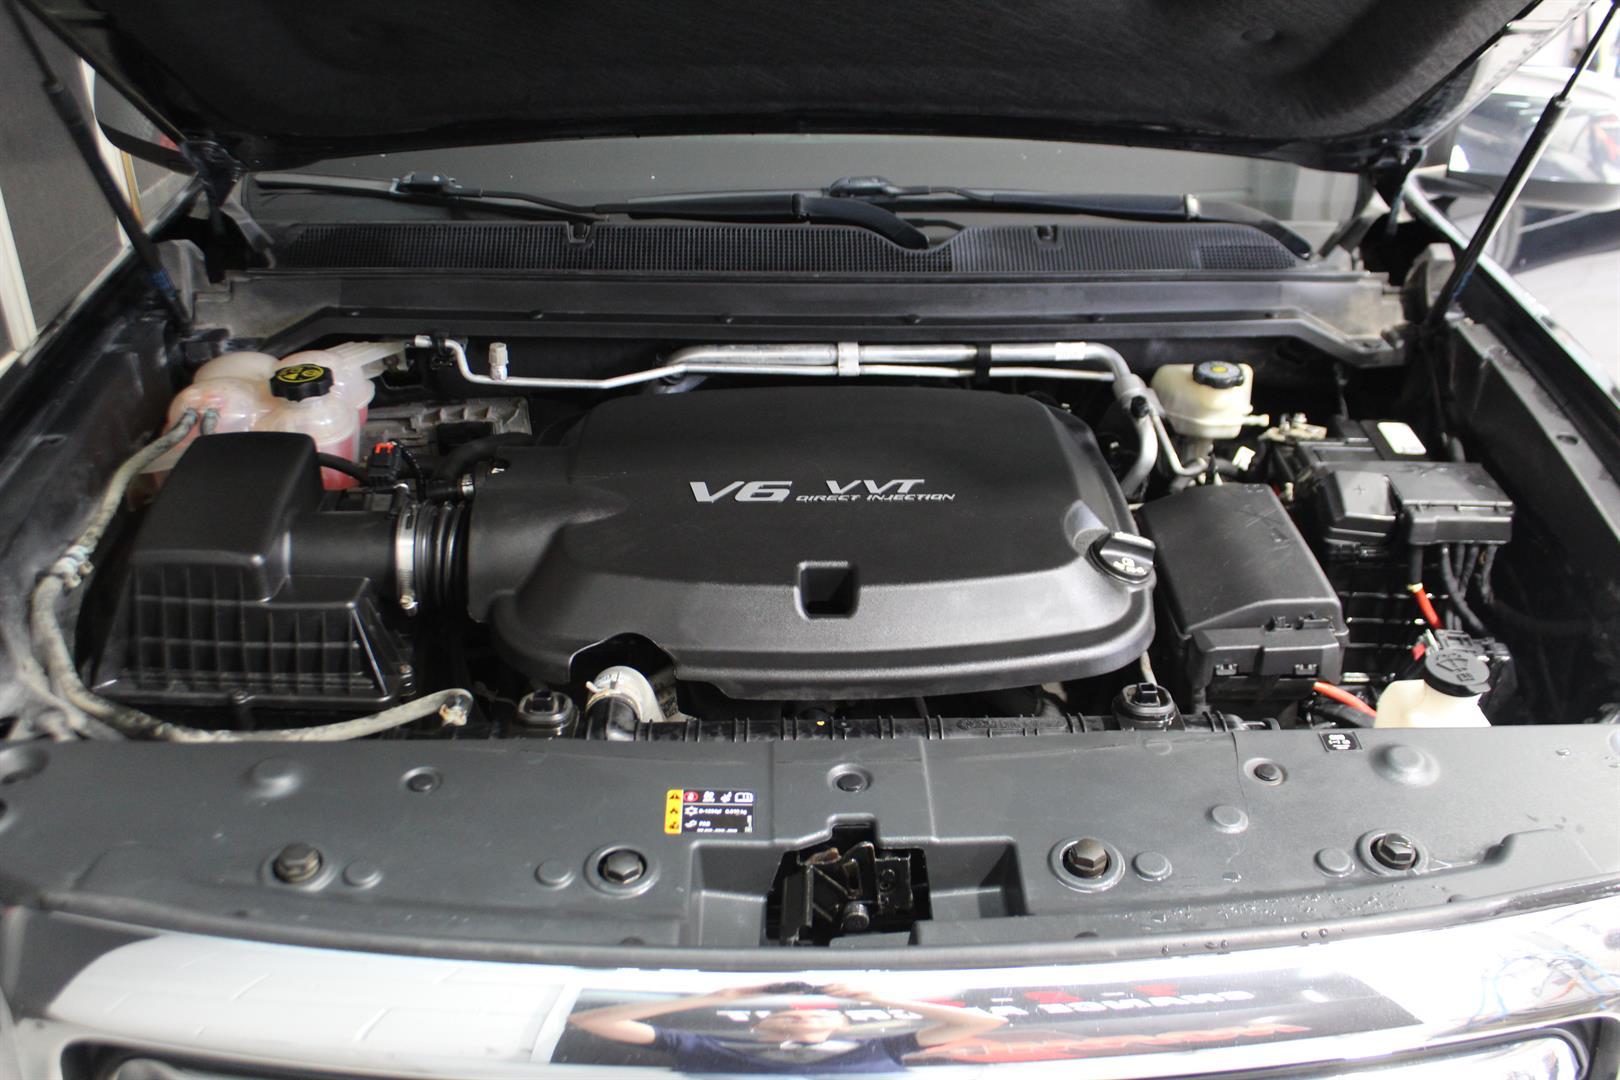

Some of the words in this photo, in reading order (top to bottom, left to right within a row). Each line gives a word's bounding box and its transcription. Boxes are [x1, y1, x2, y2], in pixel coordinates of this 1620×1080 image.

[689, 480, 793, 503] V6
[825, 479, 925, 495] VVT
[796, 494, 861, 503] DIRECT
[866, 493, 956, 503] INJECTION
